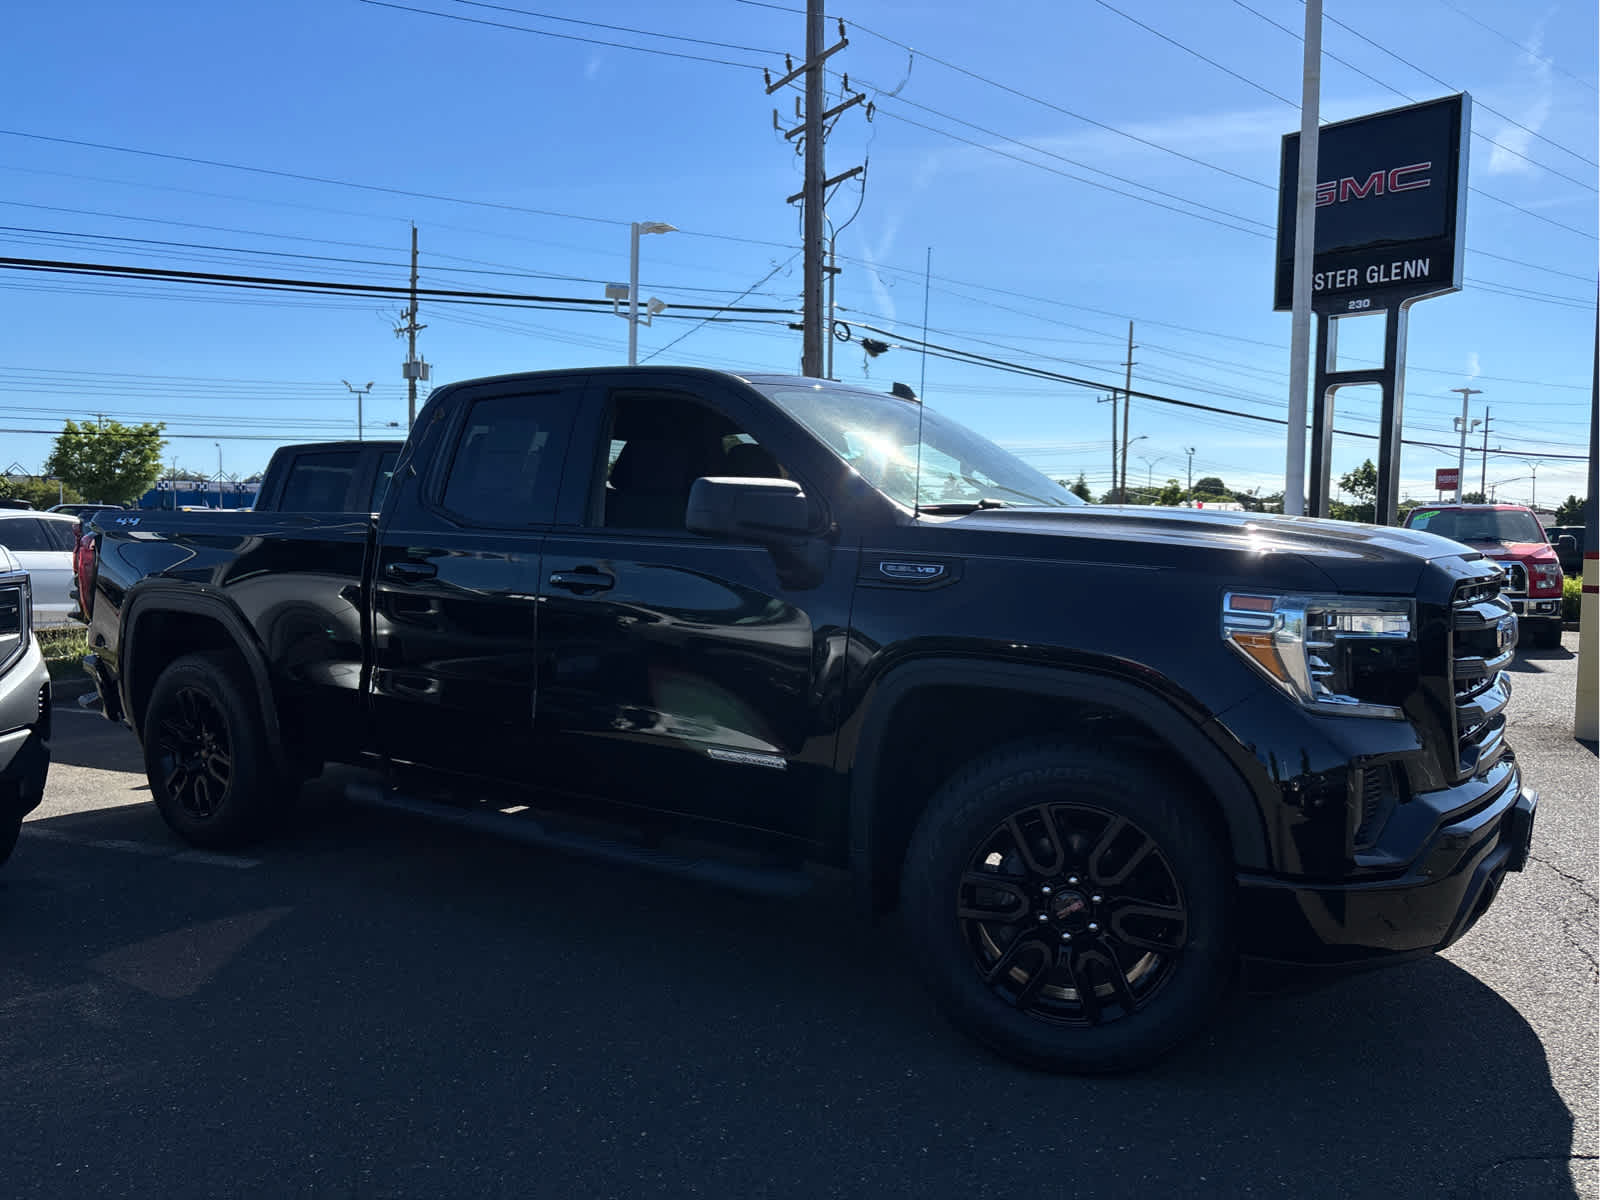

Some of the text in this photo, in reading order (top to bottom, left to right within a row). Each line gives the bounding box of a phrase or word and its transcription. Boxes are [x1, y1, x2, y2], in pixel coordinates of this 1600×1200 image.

[1312, 258, 1430, 291] STER GLENN
[1348, 298, 1371, 310] 230
